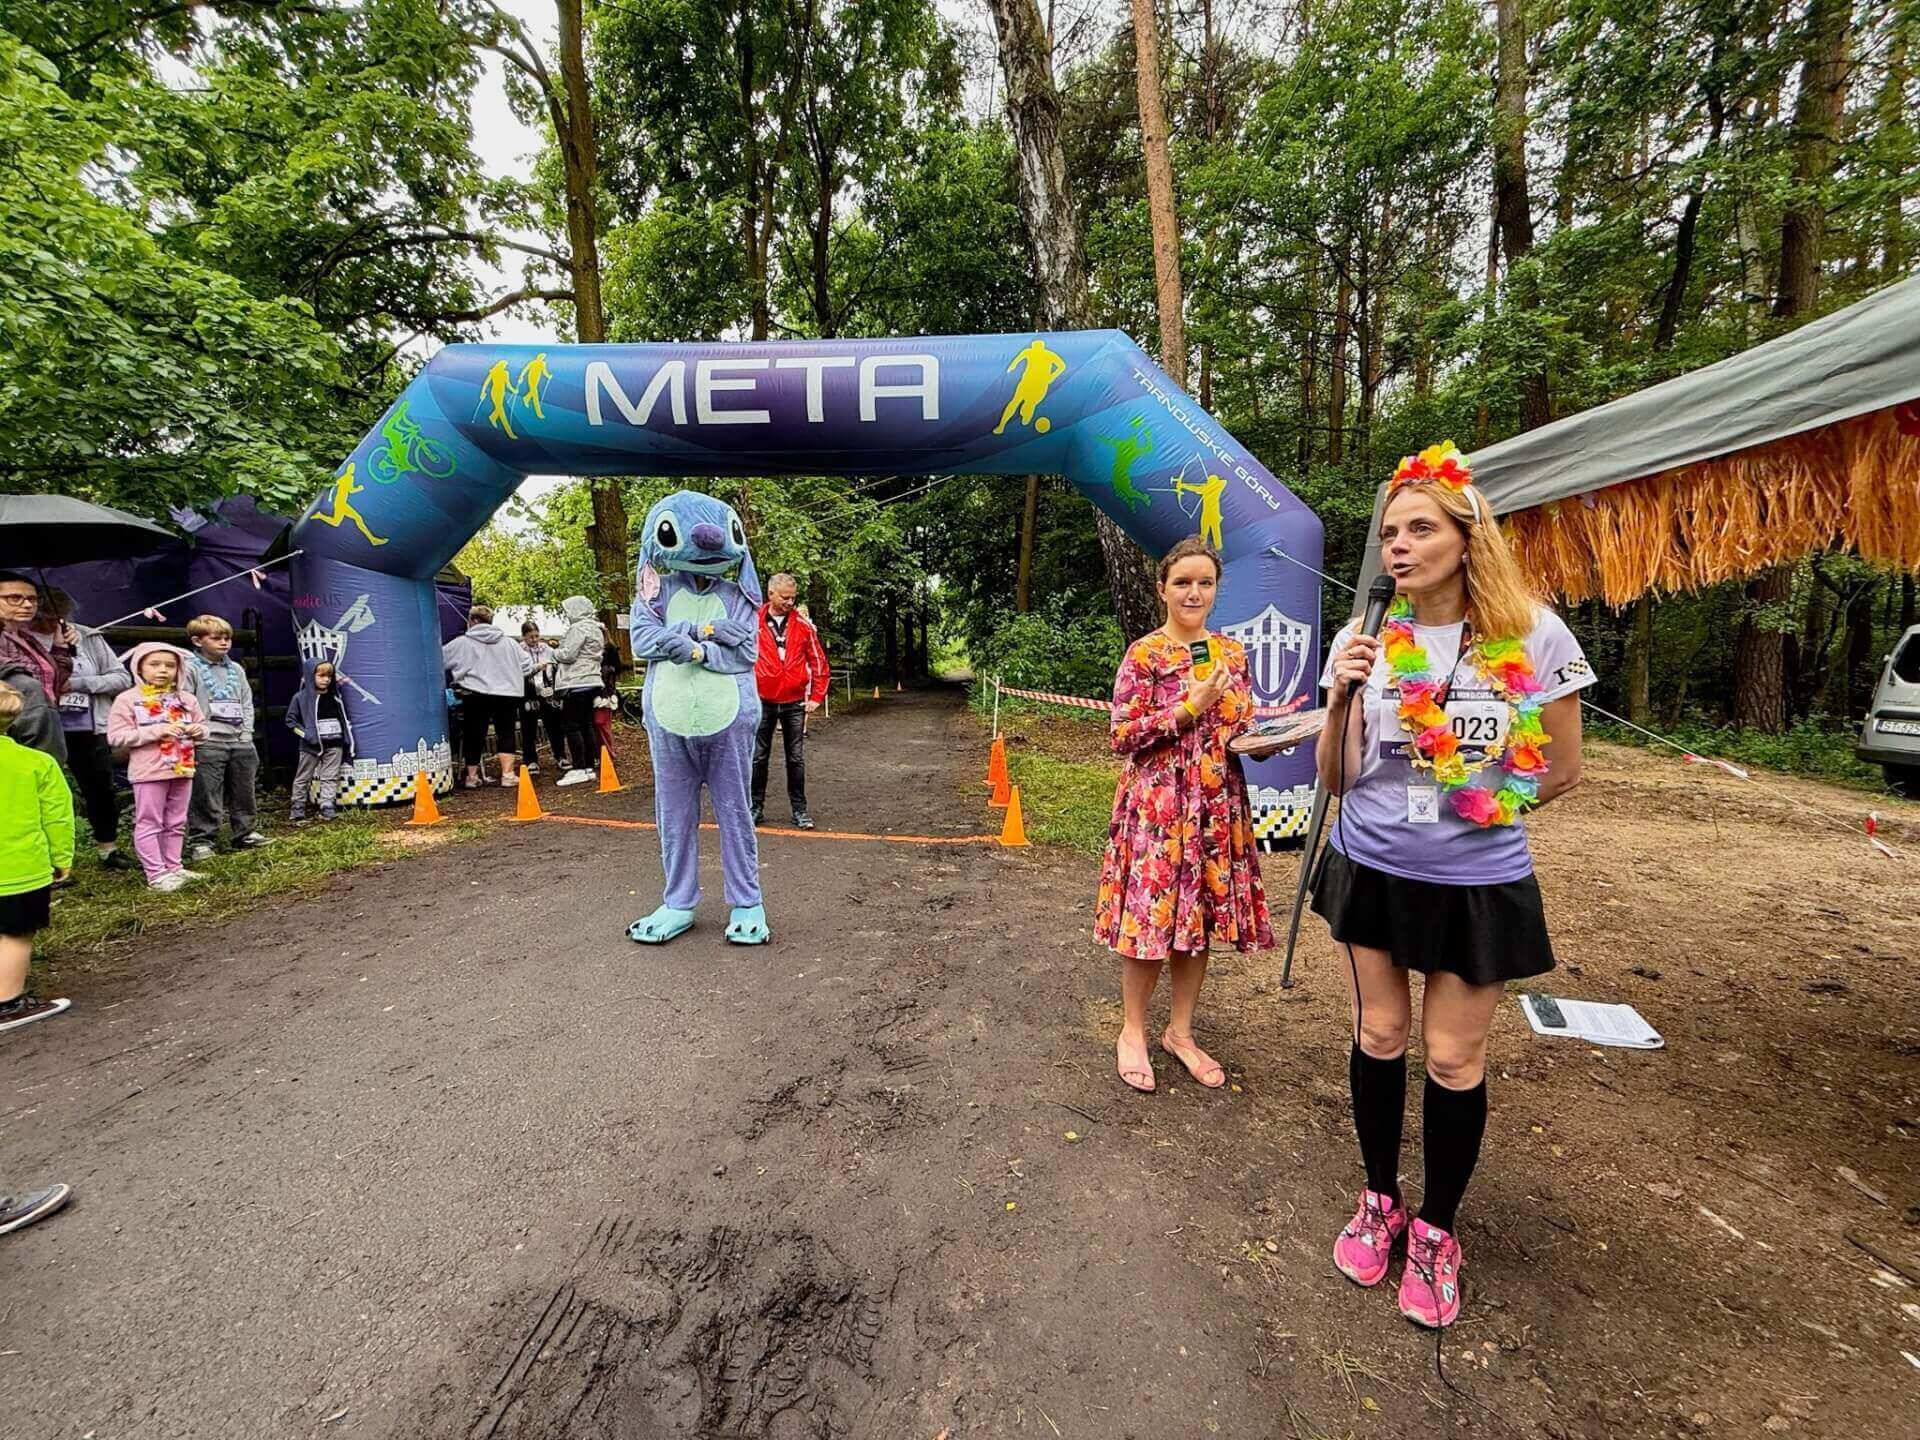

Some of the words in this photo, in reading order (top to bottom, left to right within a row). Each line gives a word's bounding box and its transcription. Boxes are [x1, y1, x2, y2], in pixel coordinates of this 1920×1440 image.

[585, 354, 939, 425] META
[1132, 368, 1235, 467] TARNOWSKIE
[1234, 466, 1280, 510] GÓRY
[64, 695, 85, 705] 229
[1452, 717, 1498, 741] 023
